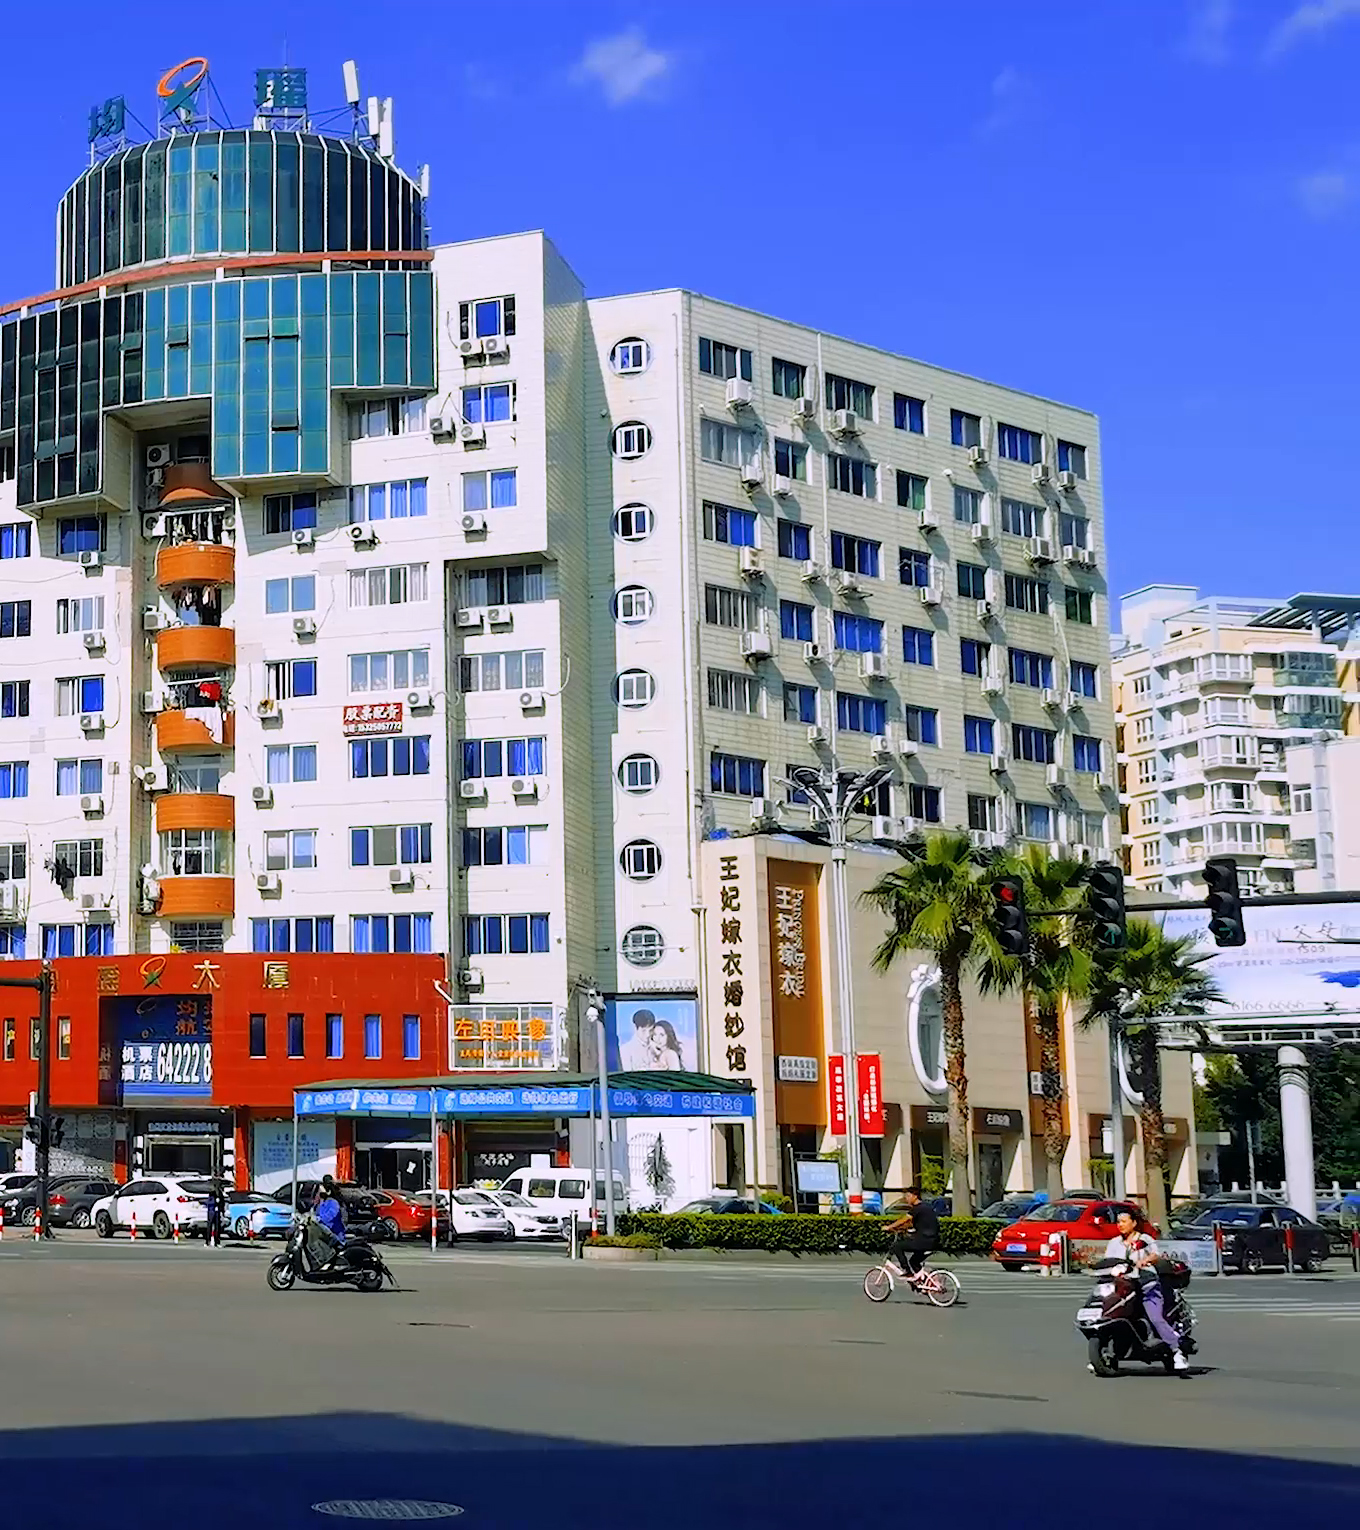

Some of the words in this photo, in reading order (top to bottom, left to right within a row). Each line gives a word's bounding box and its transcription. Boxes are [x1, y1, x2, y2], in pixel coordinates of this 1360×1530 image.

[719, 854, 747, 1073] 王妃嫁衣婚纱馆
